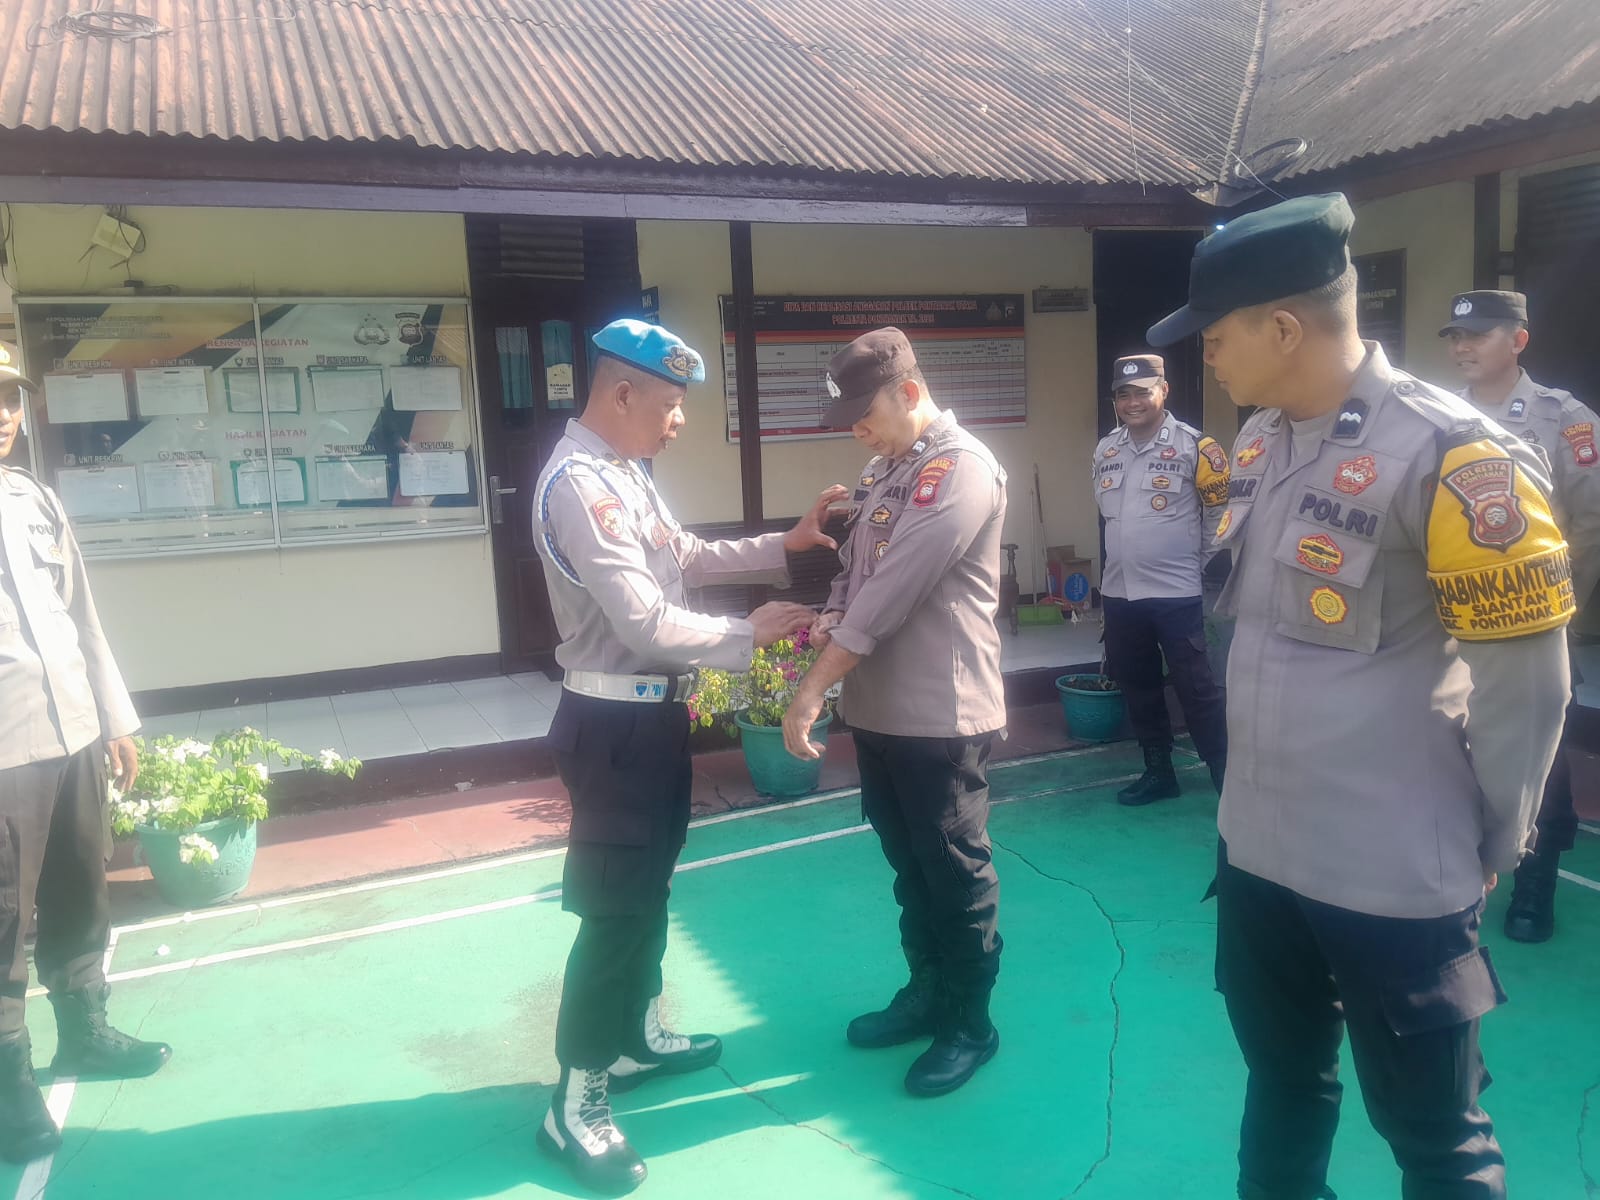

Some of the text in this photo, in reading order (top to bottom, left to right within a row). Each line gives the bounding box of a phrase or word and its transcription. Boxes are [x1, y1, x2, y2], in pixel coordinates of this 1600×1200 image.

[260, 337, 309, 348] EGIATAN
[255, 429, 307, 439] KGIATAN
[1149, 463, 1180, 473] POLRI
[1456, 464, 1507, 484] POLRESTA
[1299, 493, 1378, 537] POLRI
[1472, 590, 1548, 617] SIANTAN
[1470, 604, 1552, 630] PONTIANAK
